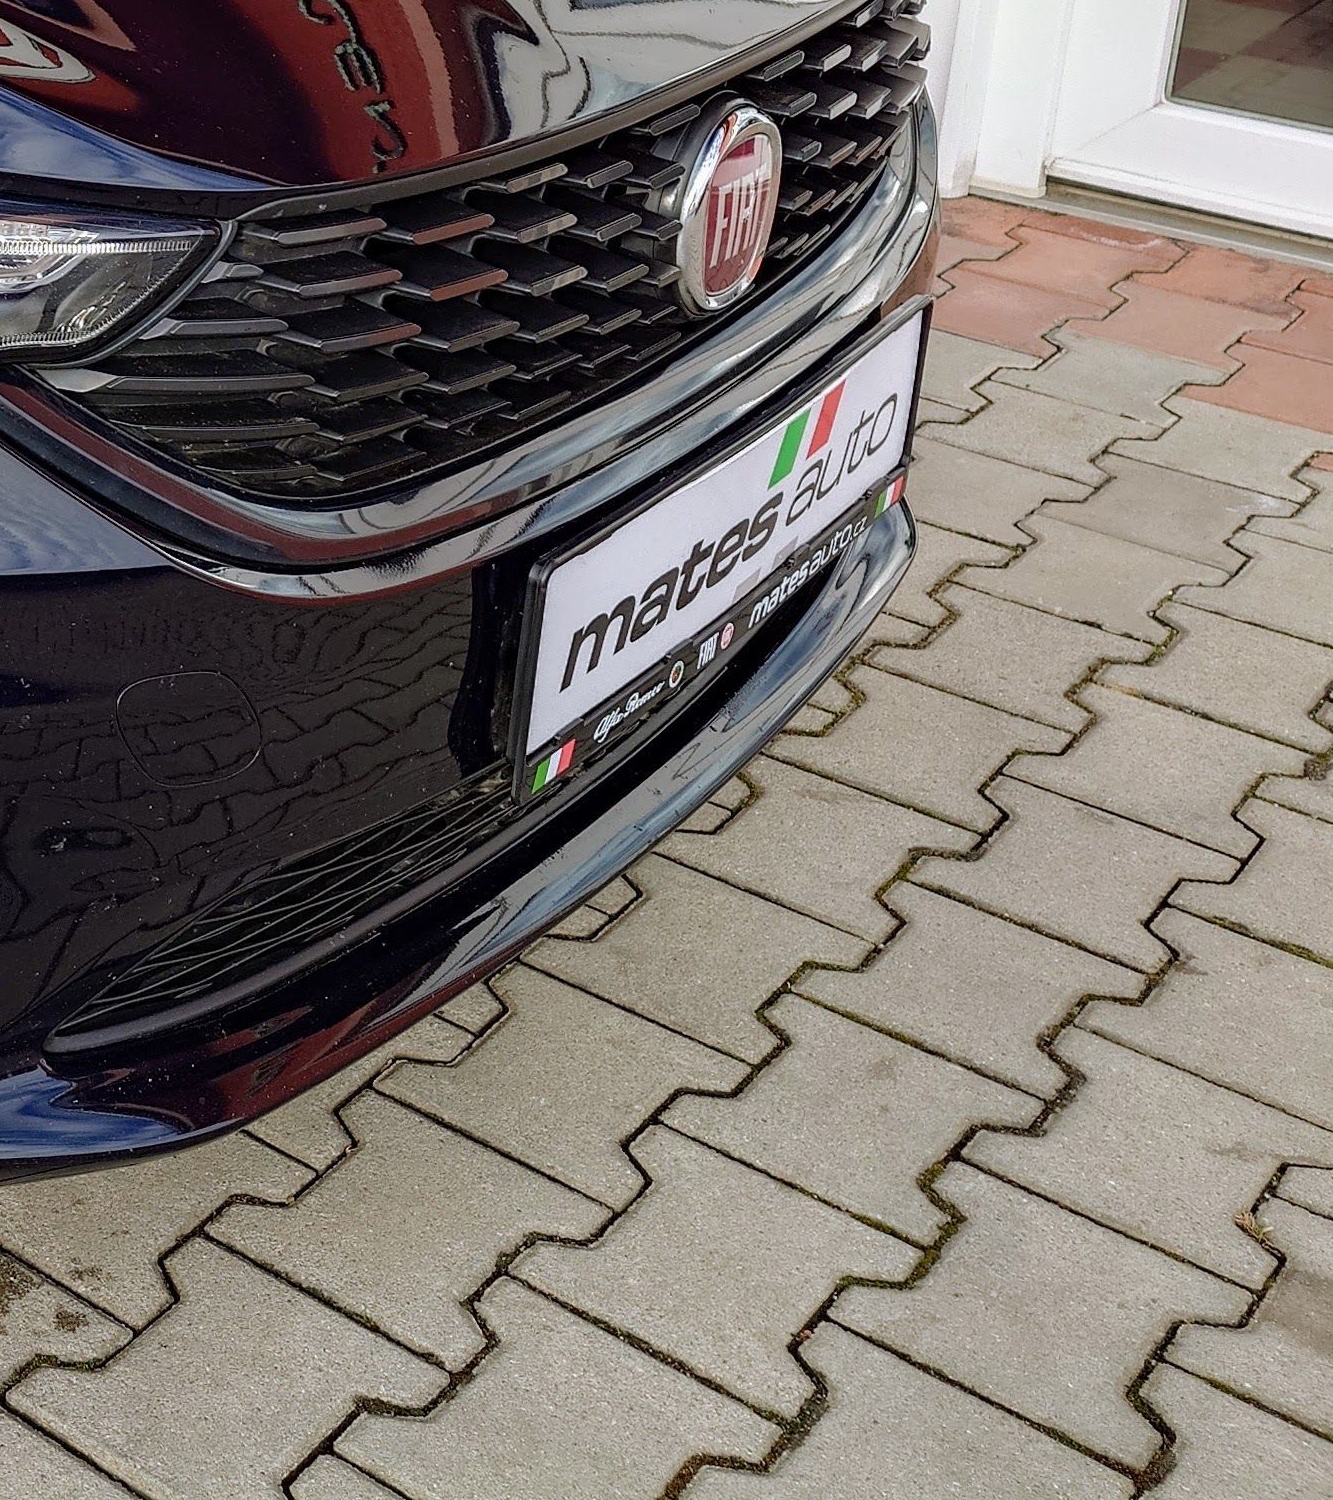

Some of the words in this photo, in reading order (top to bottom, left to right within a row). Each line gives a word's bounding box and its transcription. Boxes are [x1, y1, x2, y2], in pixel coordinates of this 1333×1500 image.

[709, 163, 770, 270] FIAT
[559, 490, 784, 693] mates
[785, 392, 898, 526] auto
[696, 631, 720, 670] FIAT
[748, 515, 868, 629] matesauto.cz
